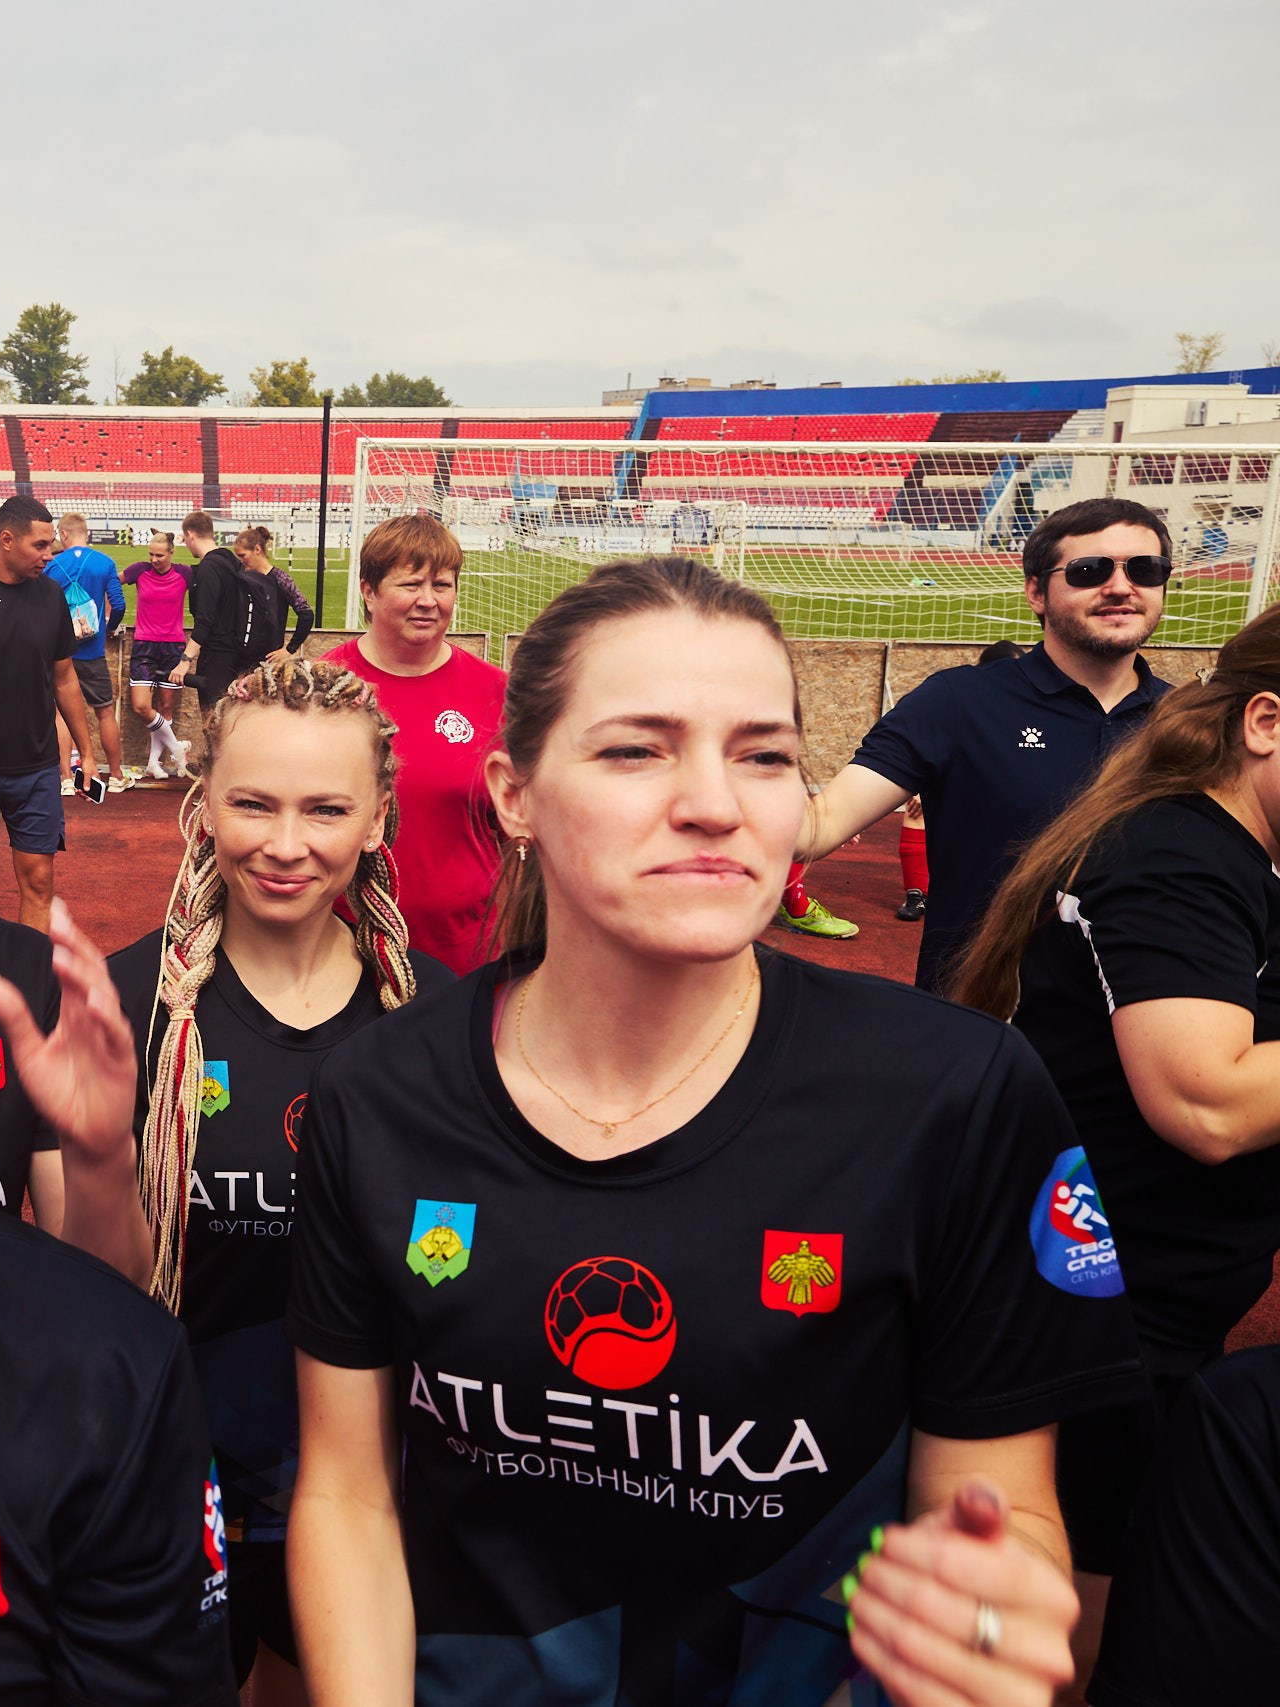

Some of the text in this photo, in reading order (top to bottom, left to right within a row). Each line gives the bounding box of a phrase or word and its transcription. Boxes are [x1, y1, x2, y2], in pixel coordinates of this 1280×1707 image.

[189, 1169, 297, 1213] ATL
[1071, 1269, 1099, 1284] СЕТЬ
[446, 1436, 785, 1520] ФУТБОЛЬНЫЙ КЛУБ
